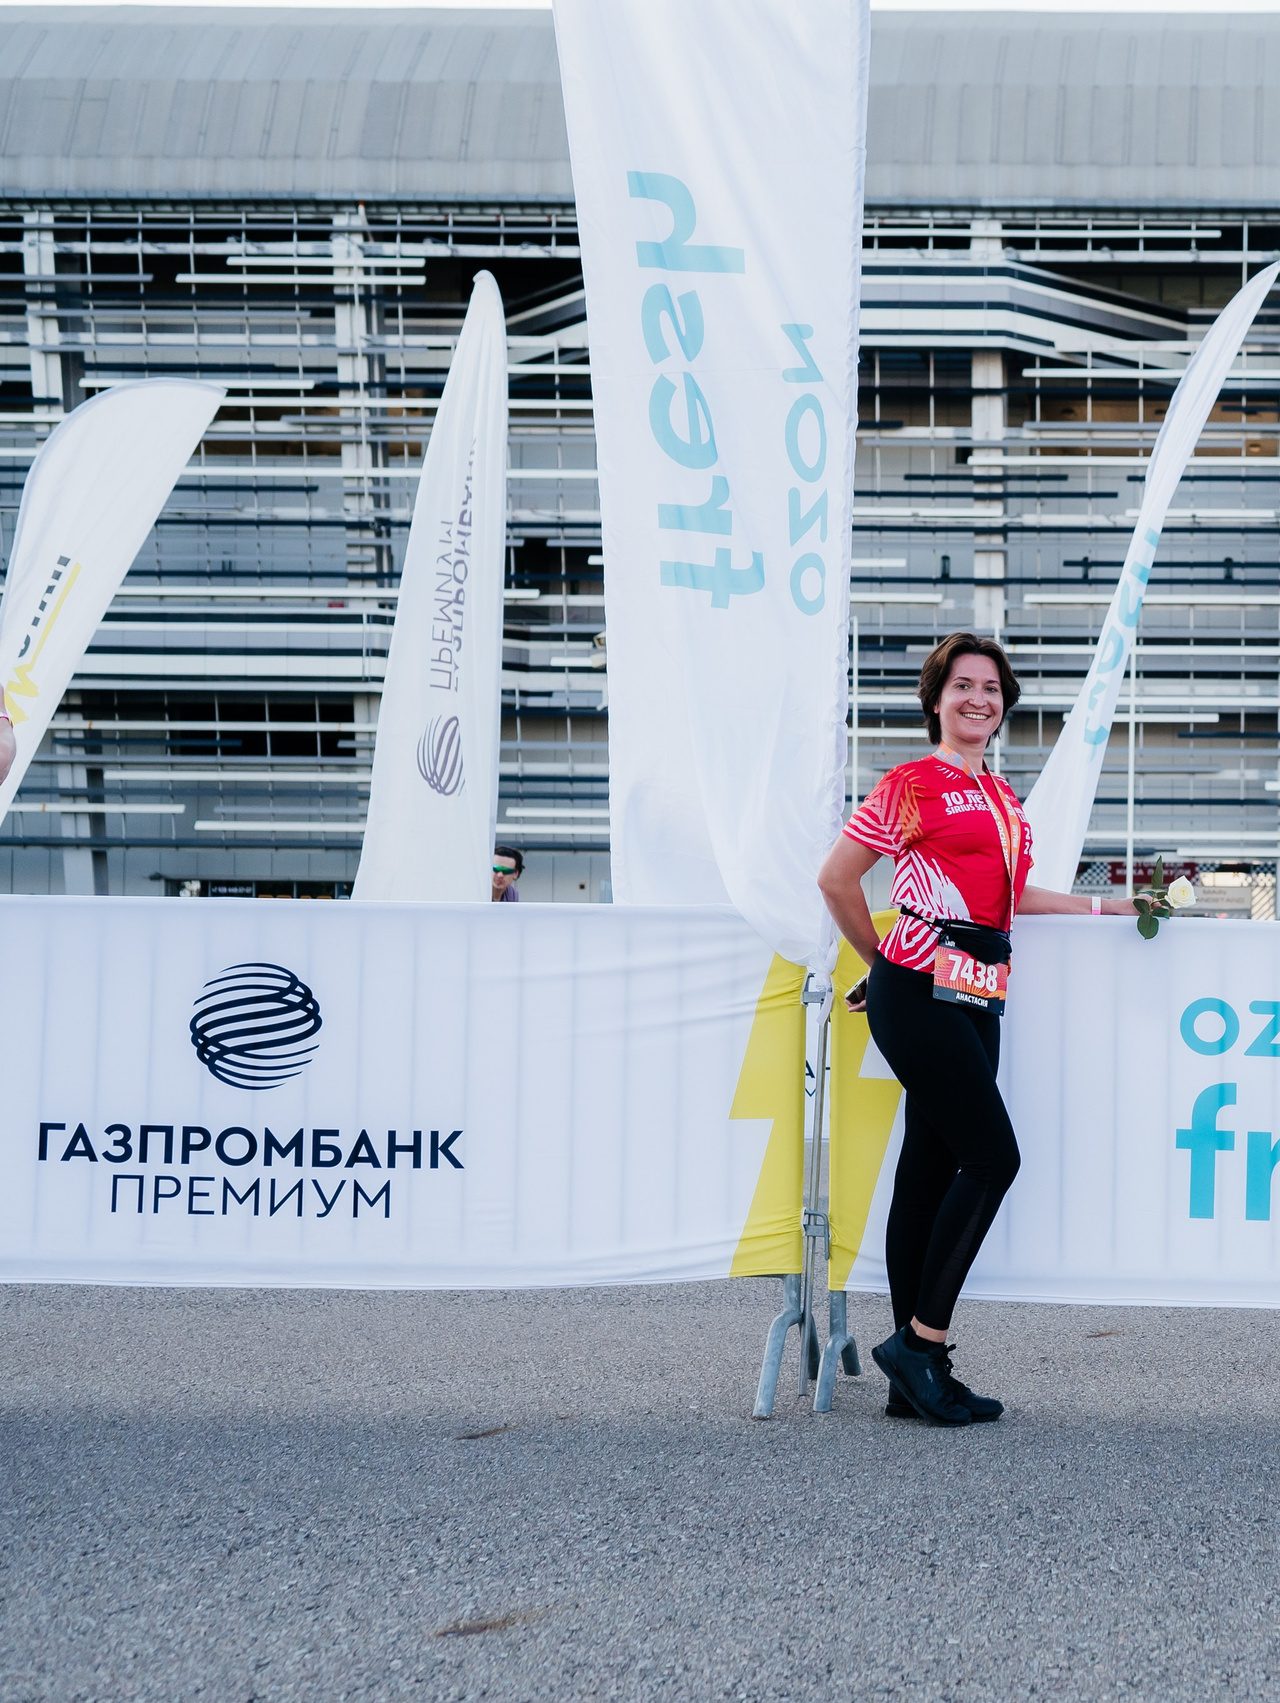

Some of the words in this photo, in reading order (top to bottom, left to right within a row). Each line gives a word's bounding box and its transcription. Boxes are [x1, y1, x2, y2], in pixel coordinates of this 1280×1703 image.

[941, 791, 964, 806] 10
[966, 794, 985, 805] ле
[945, 803, 976, 816] SIRIUS
[996, 820, 1007, 847] SOCHI
[948, 953, 998, 993] 7438
[37, 1121, 466, 1170] ГАЗПРОМБАНК
[110, 1174, 392, 1219] ПРЕМИУМ
